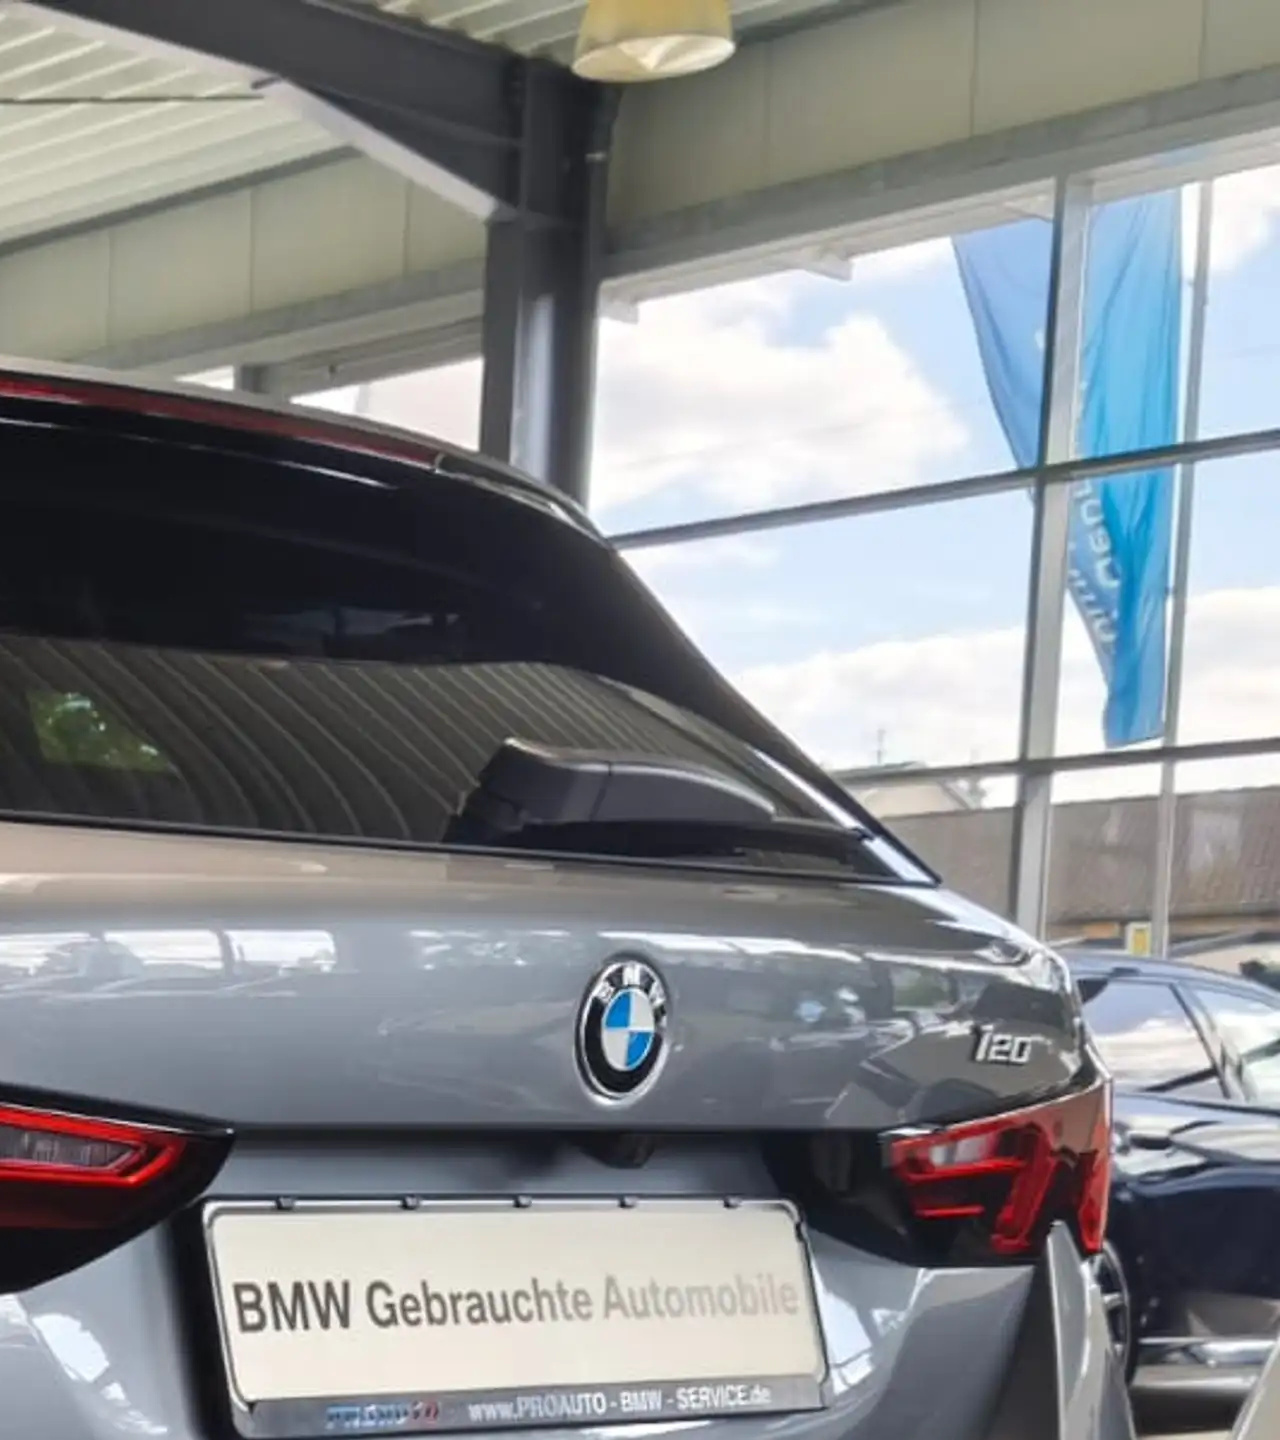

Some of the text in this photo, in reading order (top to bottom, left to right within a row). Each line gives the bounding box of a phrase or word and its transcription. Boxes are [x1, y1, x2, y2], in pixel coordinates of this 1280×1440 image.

[975, 1024, 1031, 1062] 120
[233, 1272, 799, 1333] BMW Gebrauchte Automobile
[620, 1390, 662, 1412] BMW
